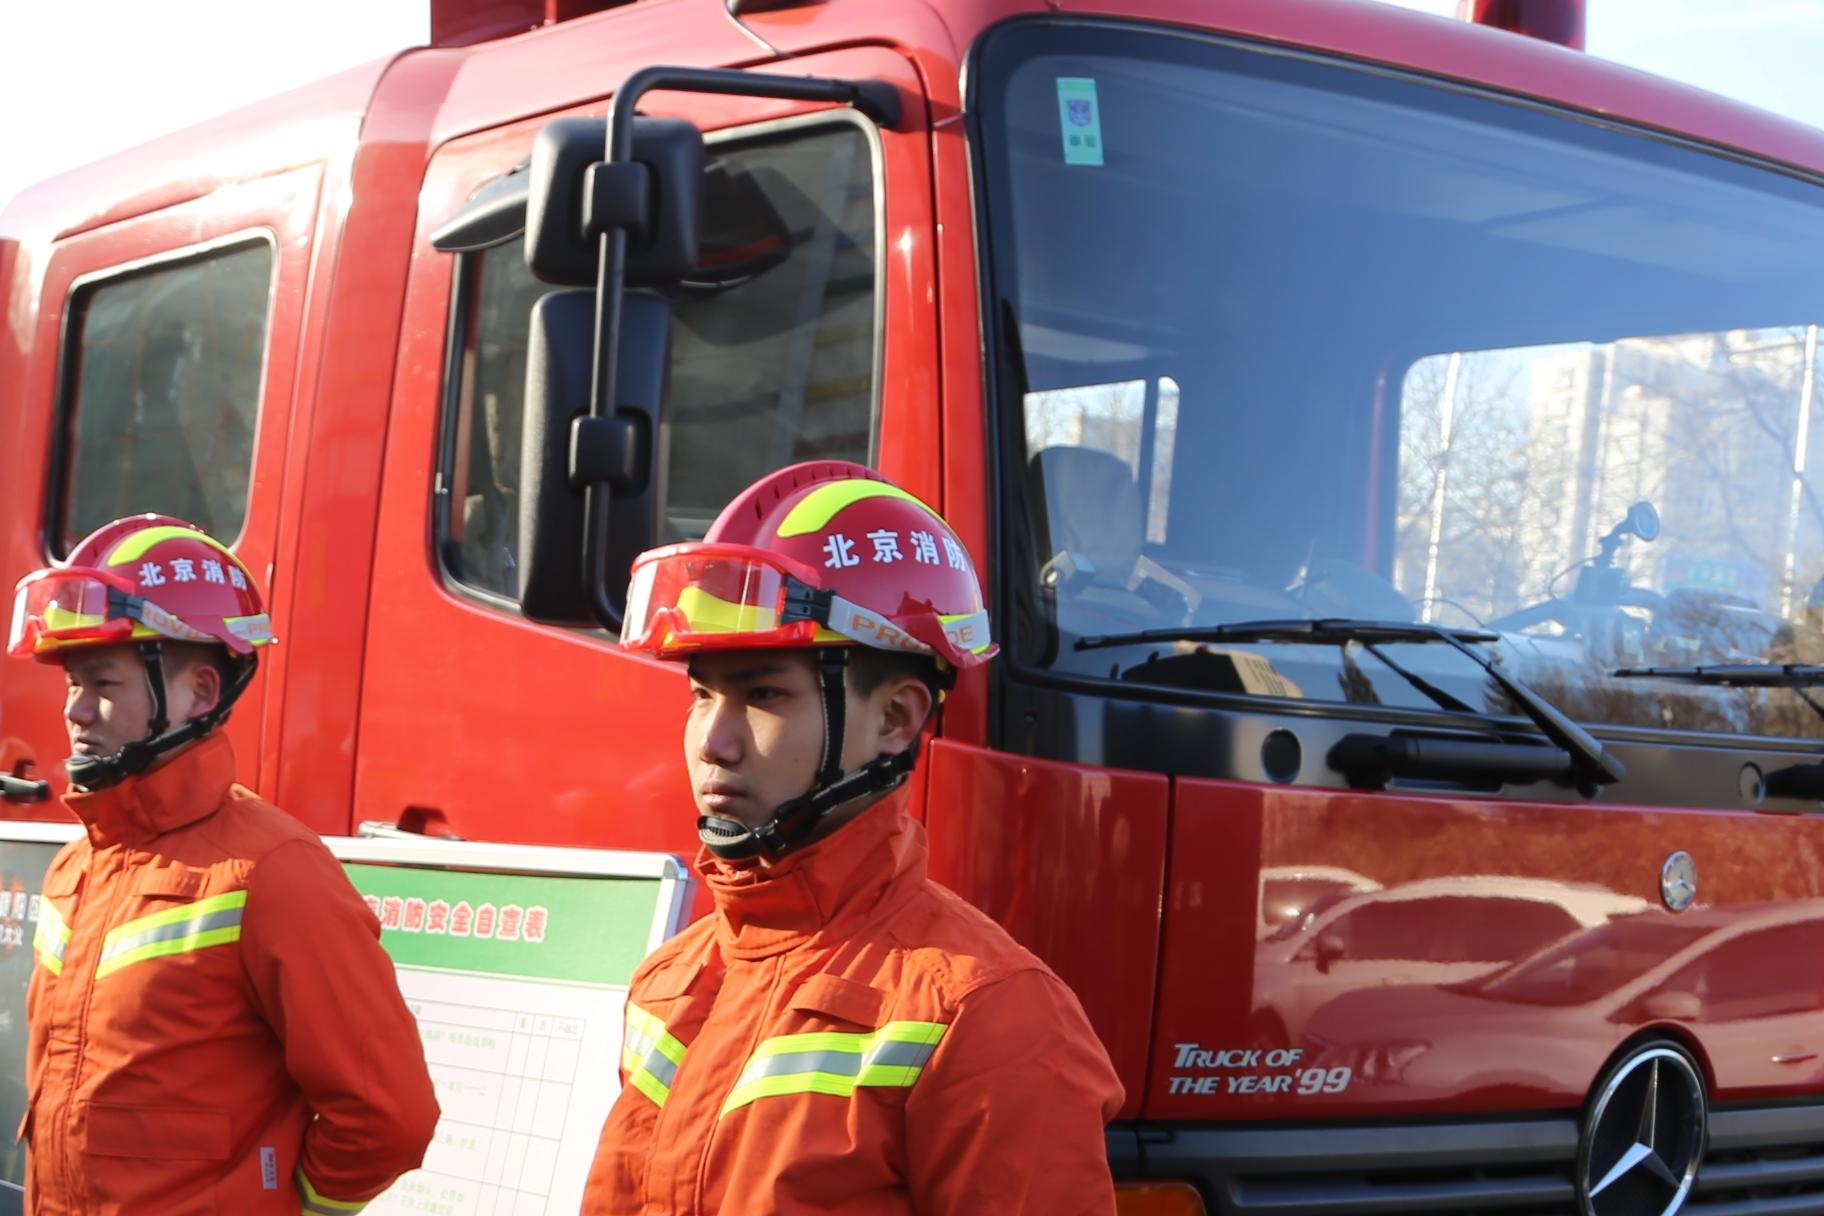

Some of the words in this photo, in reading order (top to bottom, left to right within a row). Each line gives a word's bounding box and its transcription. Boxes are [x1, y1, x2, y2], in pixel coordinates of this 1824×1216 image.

[822, 529, 966, 571] 北京消防
[139, 558, 247, 590] 北京消防
[1173, 1043, 1262, 1068] TRUCK
[1265, 1048, 1303, 1068] OF
[1169, 1077, 1221, 1095] THE
[1227, 1075, 1293, 1094] YEAR
